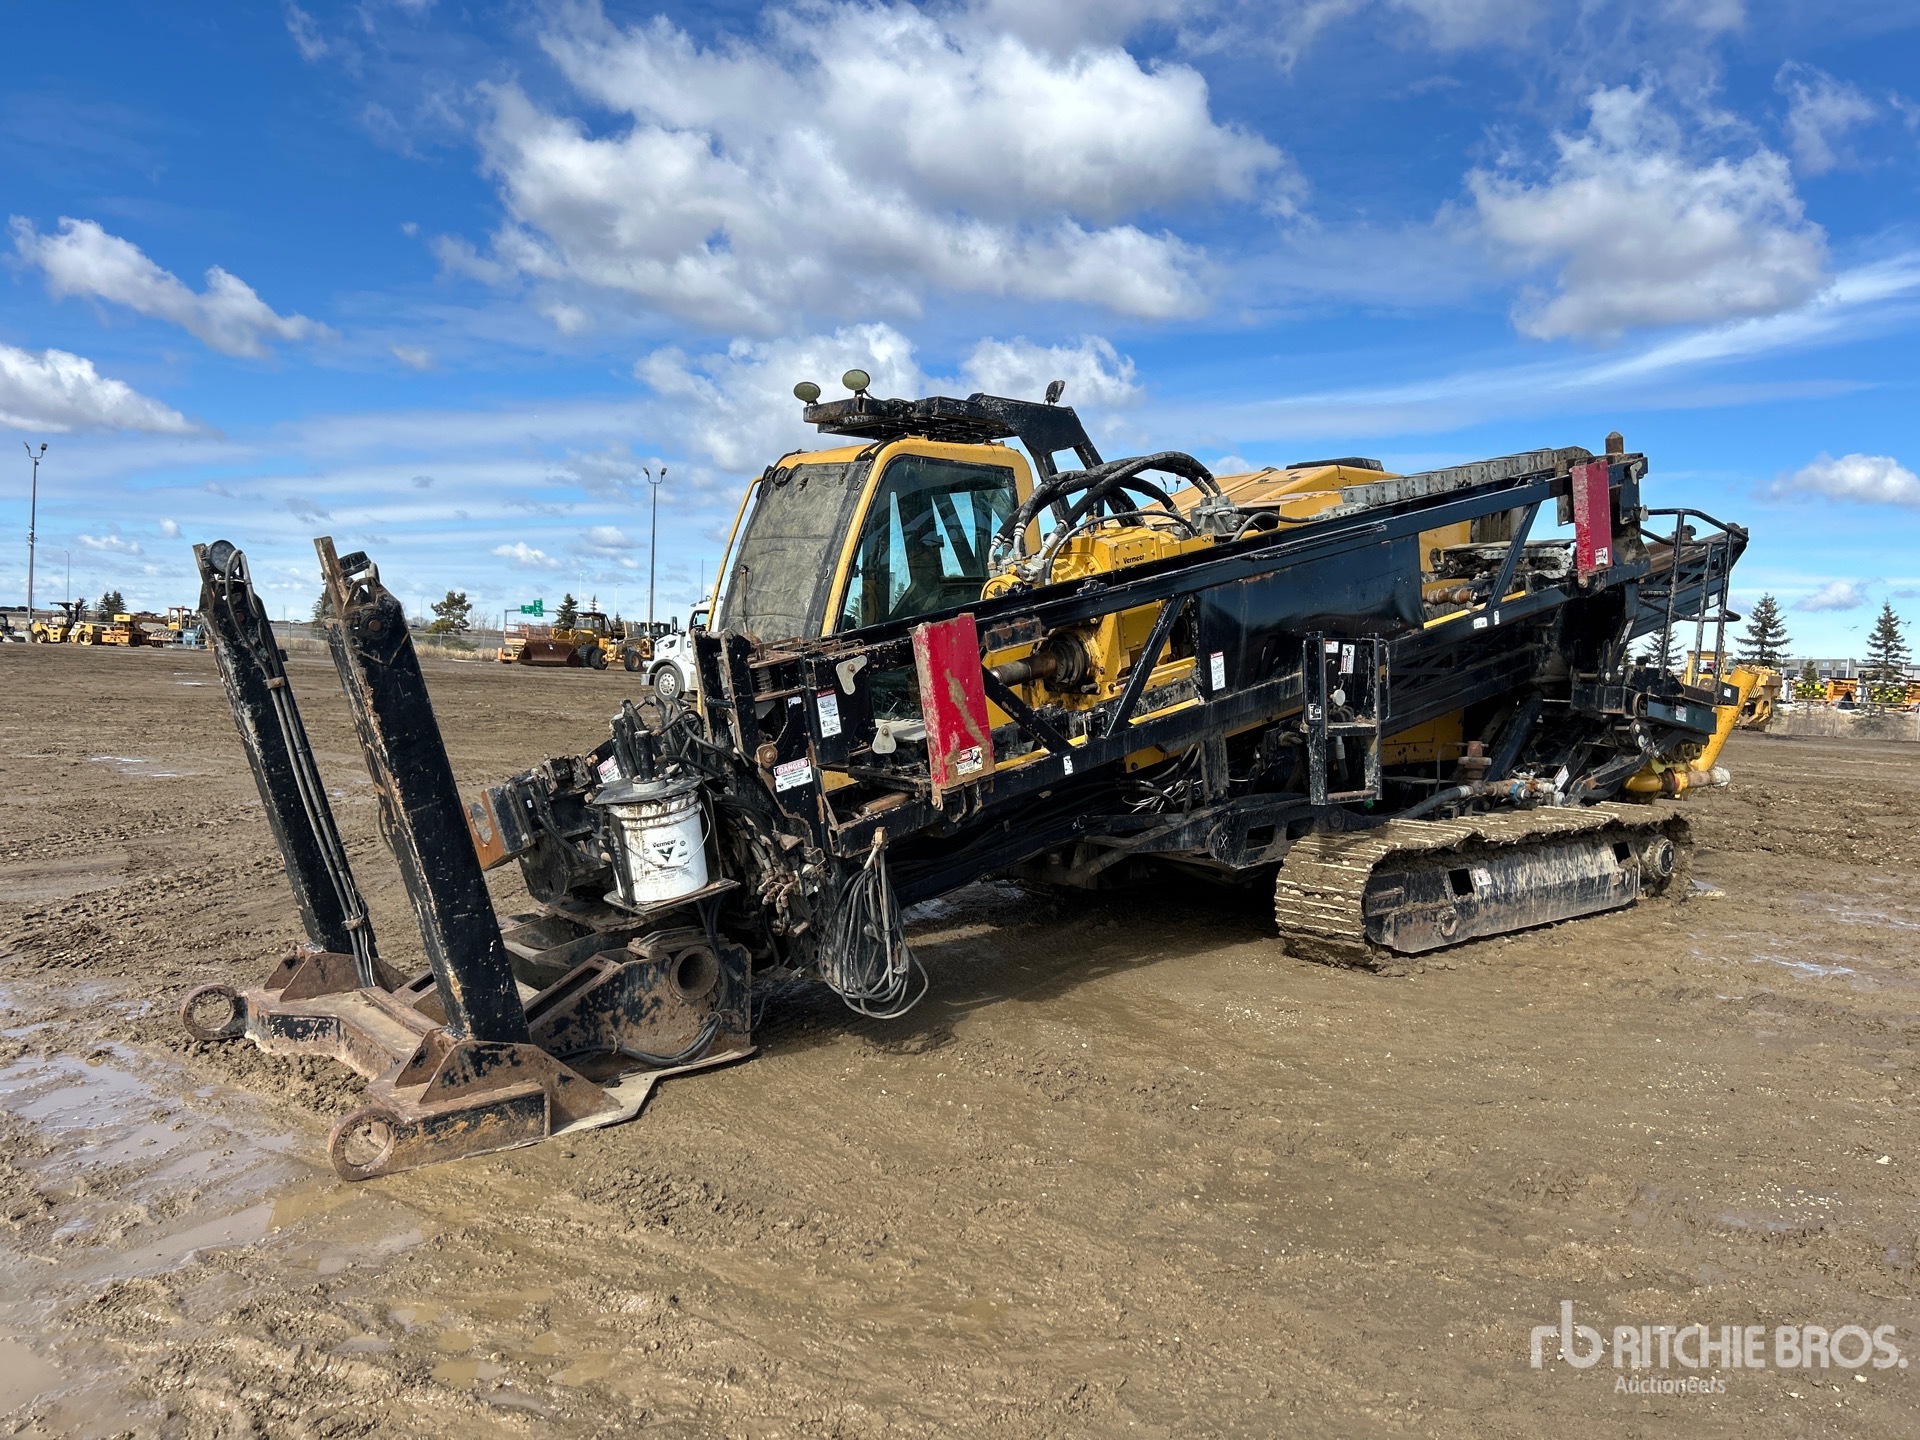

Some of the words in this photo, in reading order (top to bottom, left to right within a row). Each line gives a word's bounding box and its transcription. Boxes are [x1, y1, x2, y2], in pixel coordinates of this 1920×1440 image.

[1122, 555, 1146, 564] Vermeer
[779, 760, 807, 774] DANGER
[652, 840, 676, 848] Vermeer
